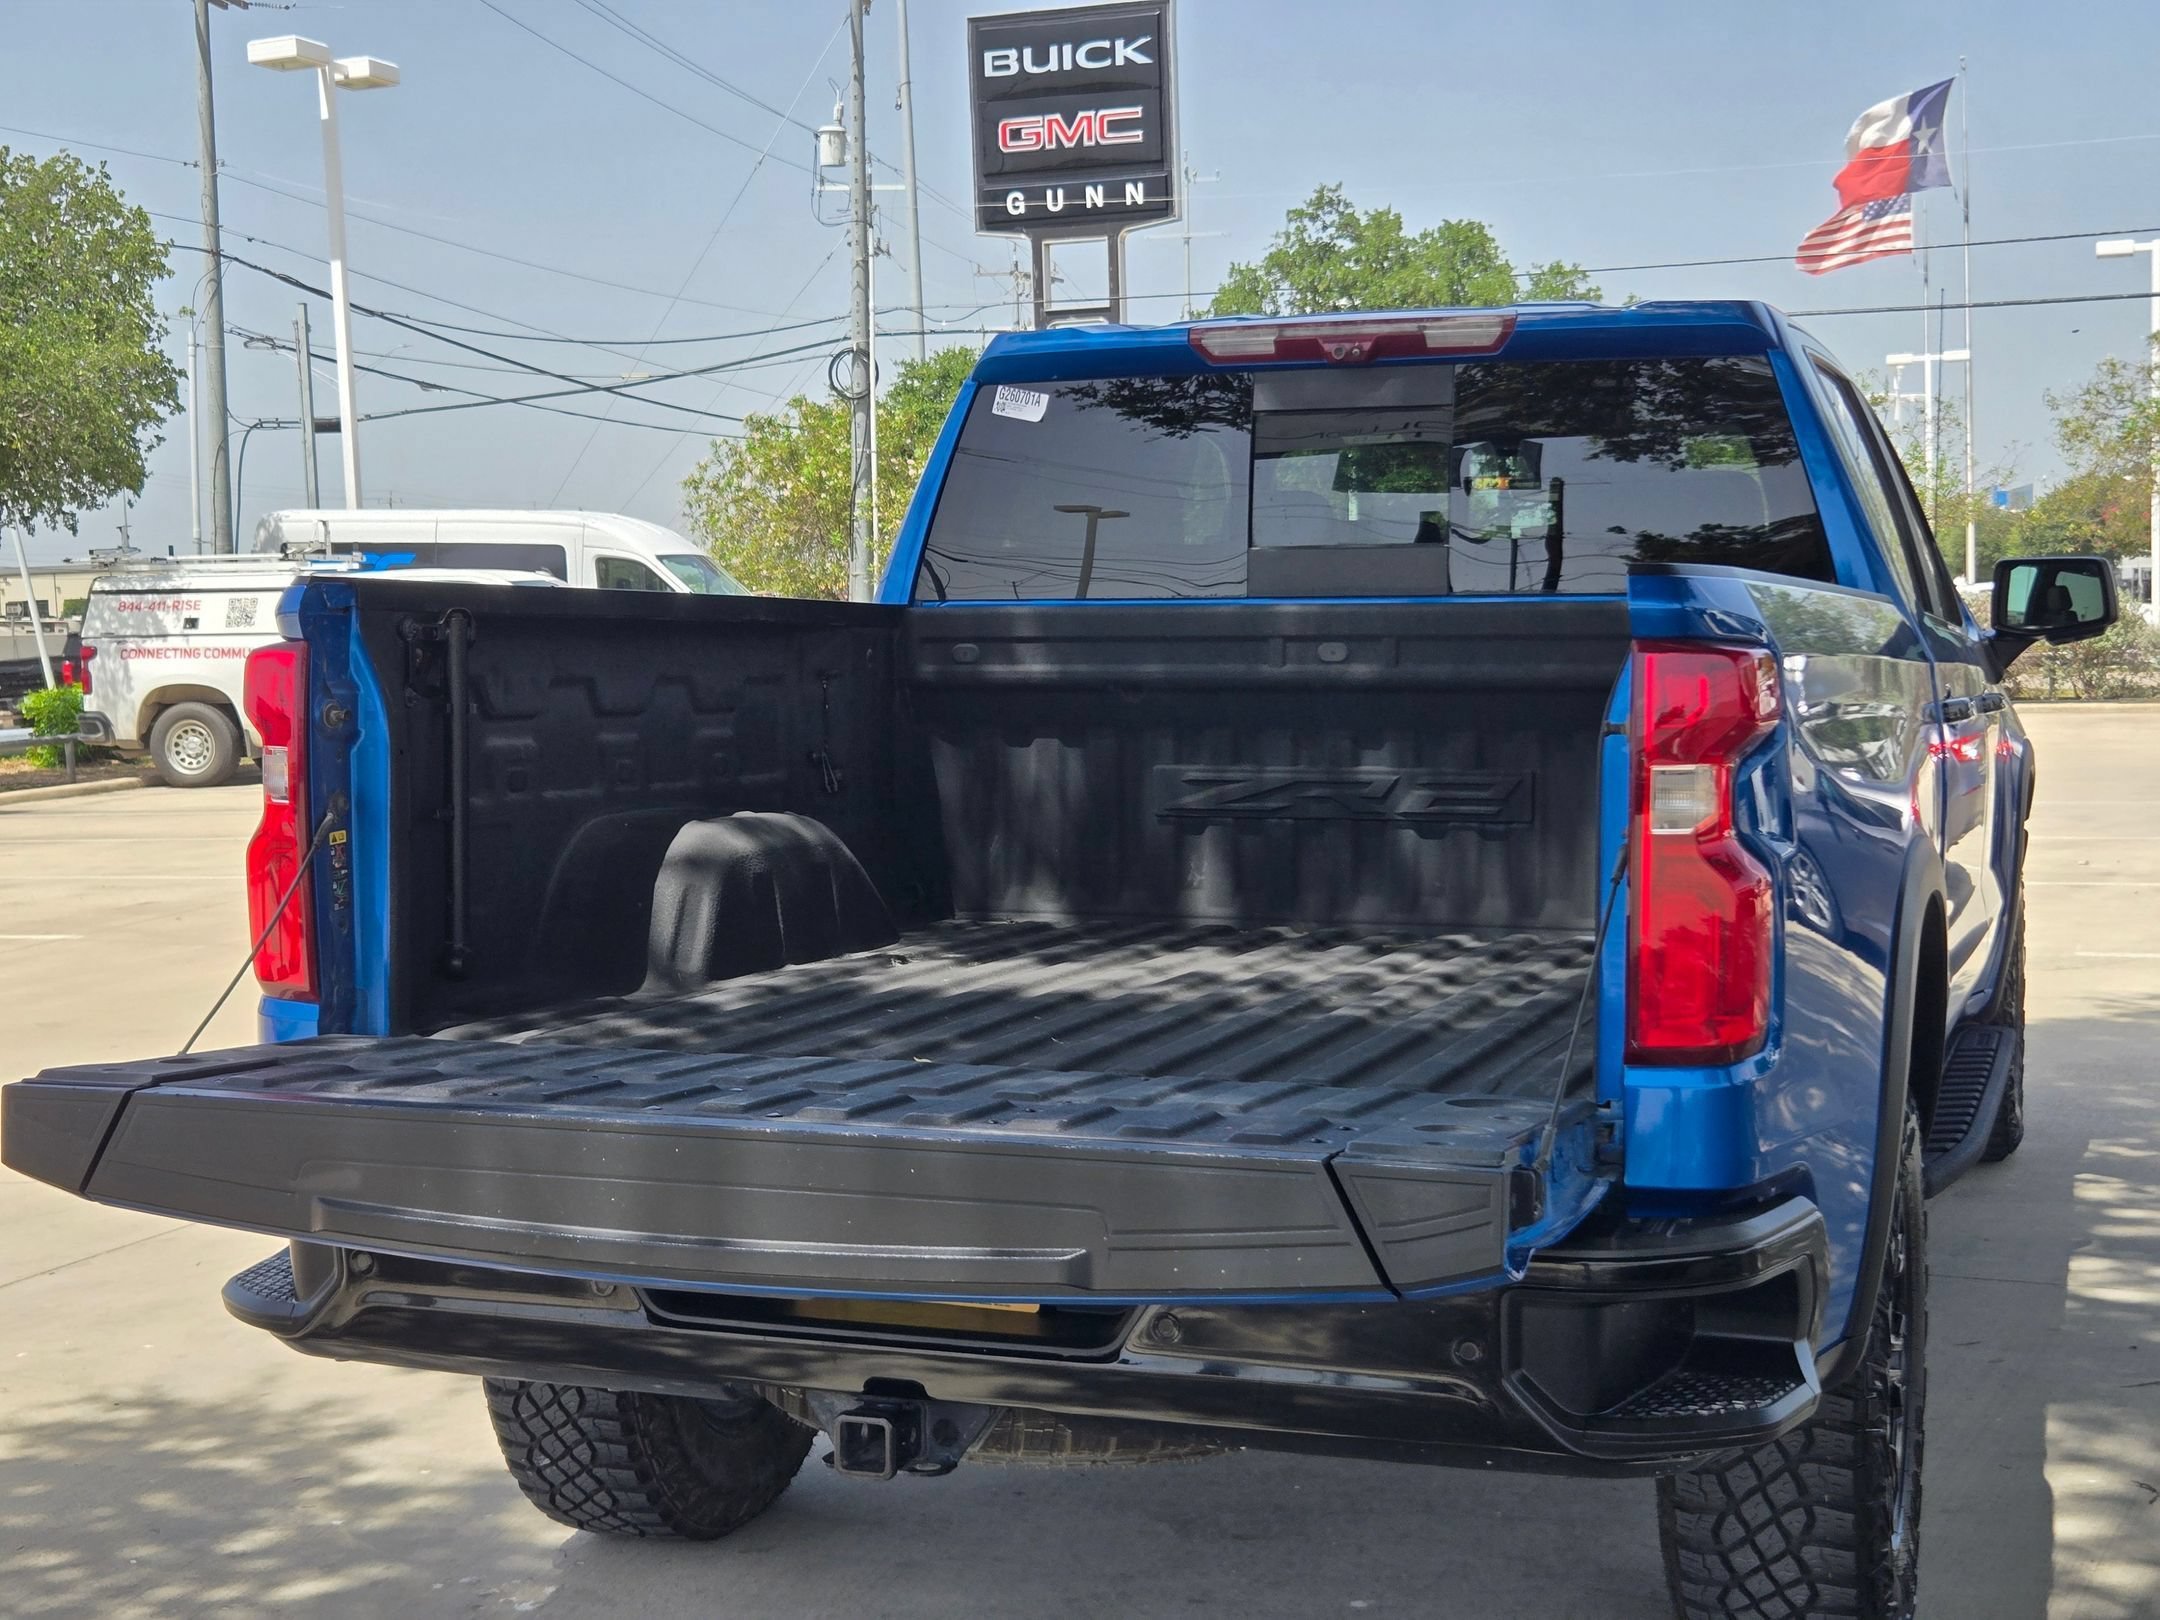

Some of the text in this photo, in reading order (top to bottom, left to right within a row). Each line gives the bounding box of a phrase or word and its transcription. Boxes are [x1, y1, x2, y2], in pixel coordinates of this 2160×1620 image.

[984, 37, 1153, 77] BUICK
[998, 105, 1144, 153] GMC
[1006, 182, 1144, 215] GUNN
[999, 387, 1040, 407] G260701A
[118, 601, 201, 612] 844-411-RISE
[120, 648, 201, 660] CONNECTING
